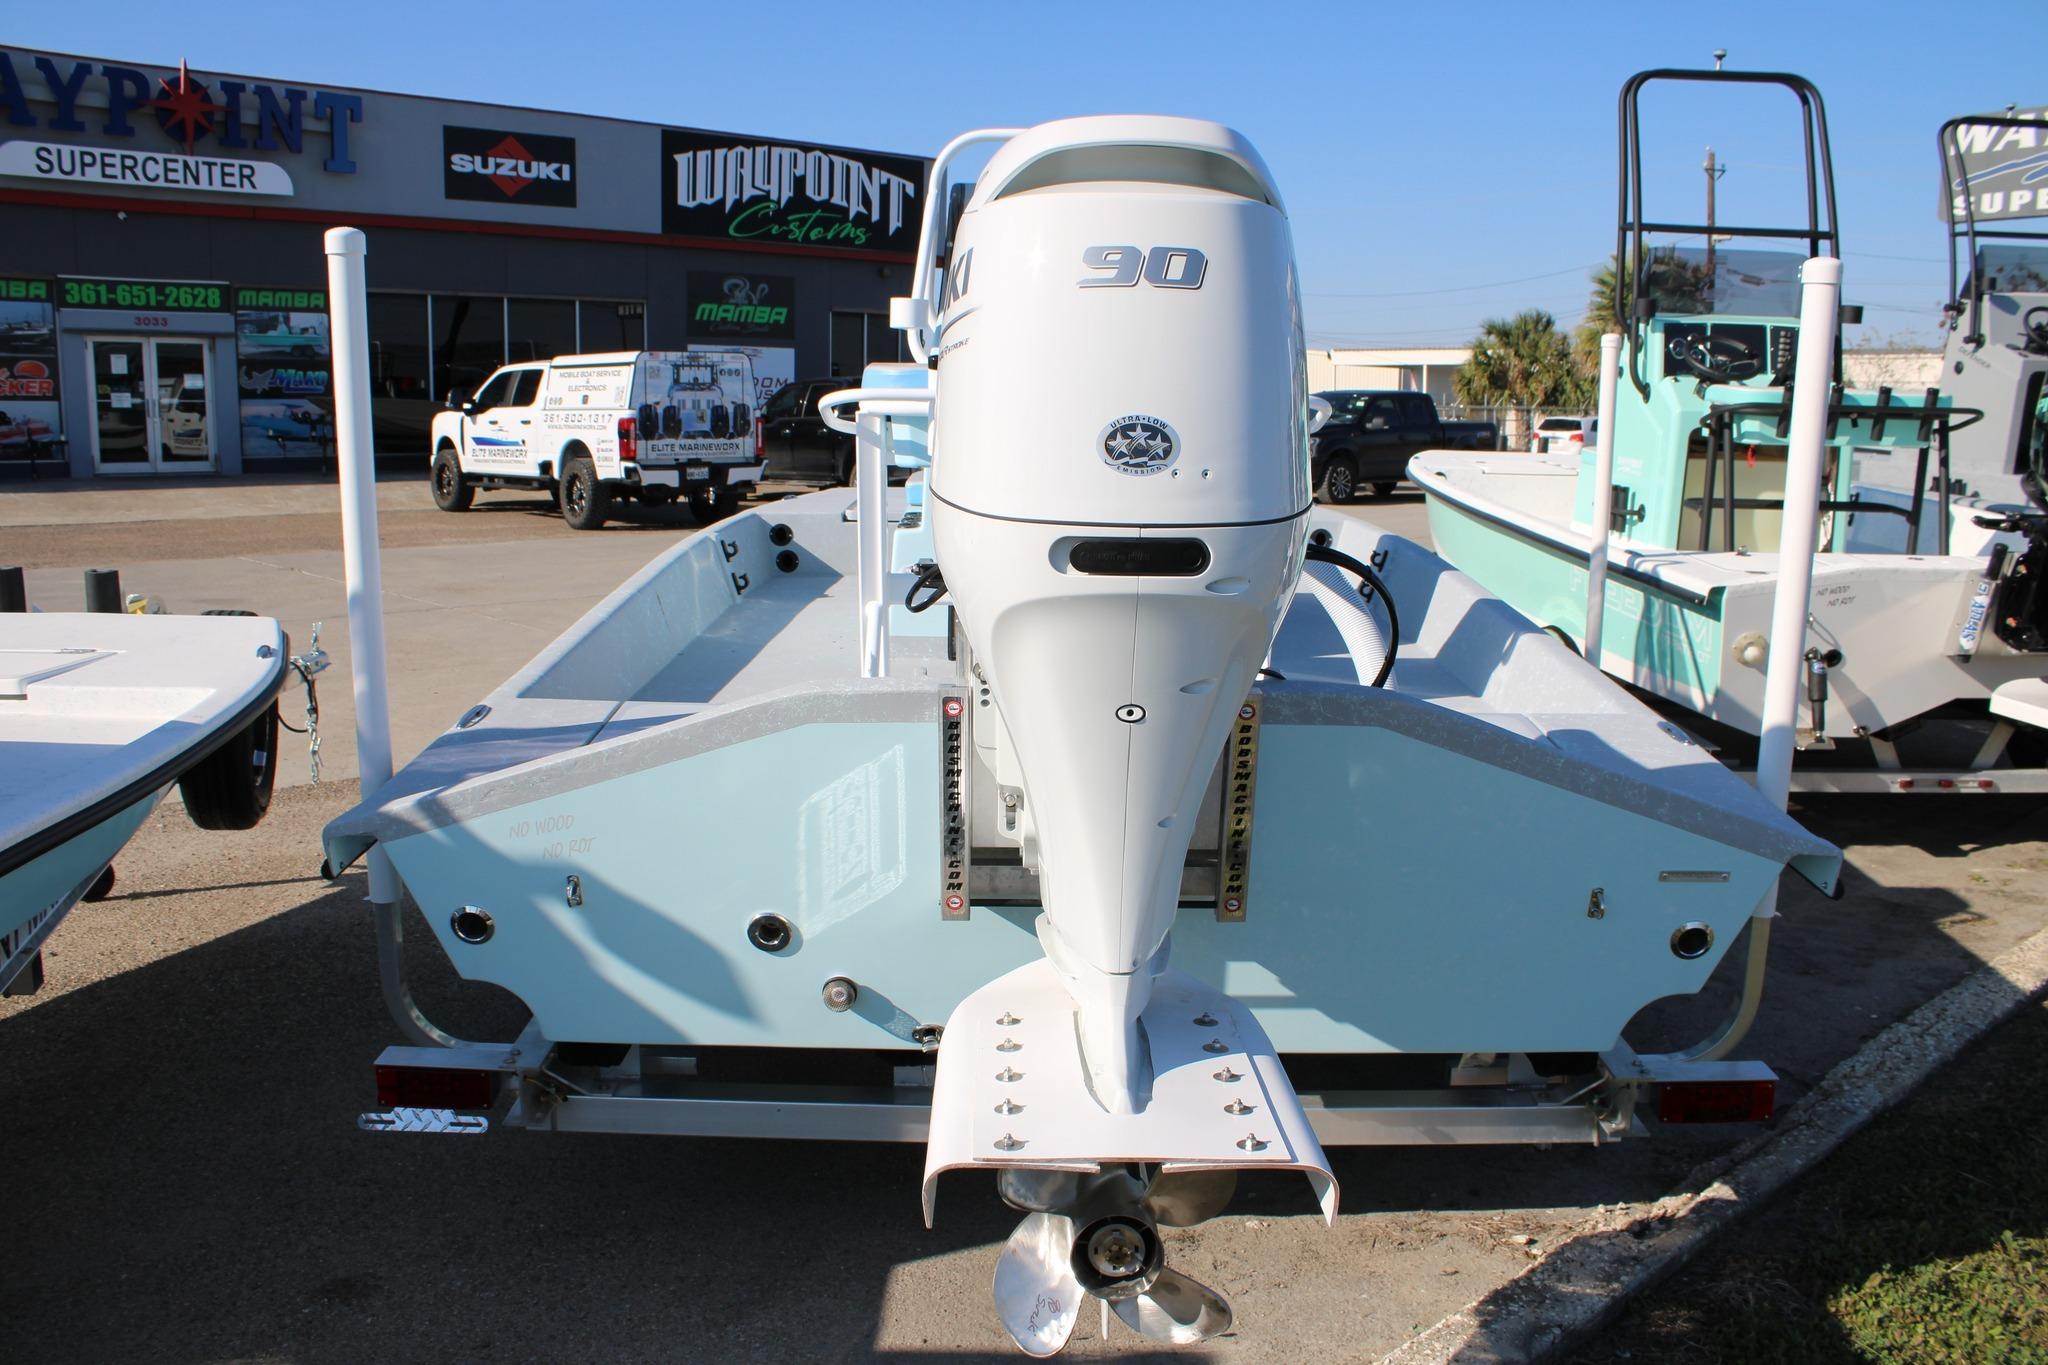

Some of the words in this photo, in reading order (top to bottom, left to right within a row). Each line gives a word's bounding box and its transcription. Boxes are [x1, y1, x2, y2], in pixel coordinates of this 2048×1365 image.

[36, 146, 257, 190] SUPERCENTER
[450, 153, 571, 182] SUZUKI
[673, 145, 916, 238] WAYPOINT
[728, 201, 872, 245] Customs
[1077, 244, 1209, 291] 90
[65, 283, 222, 309] 361-651-2628
[239, 289, 325, 309] MAMBA
[134, 316, 169, 327] 3033
[695, 303, 788, 324] MAMBA
[651, 443, 675, 452] ELITE
[679, 443, 740, 452] MARINEWORX
[1116, 465, 1162, 475] EMISSION
[945, 721, 963, 890] BOBSMACHINE.COM
[1225, 724, 1252, 893] BOBSMACHINE.COM
[509, 821, 529, 839] NO
[536, 815, 575, 835] WOOD
[543, 842, 563, 860] NO
[569, 836, 597, 856] ROT
